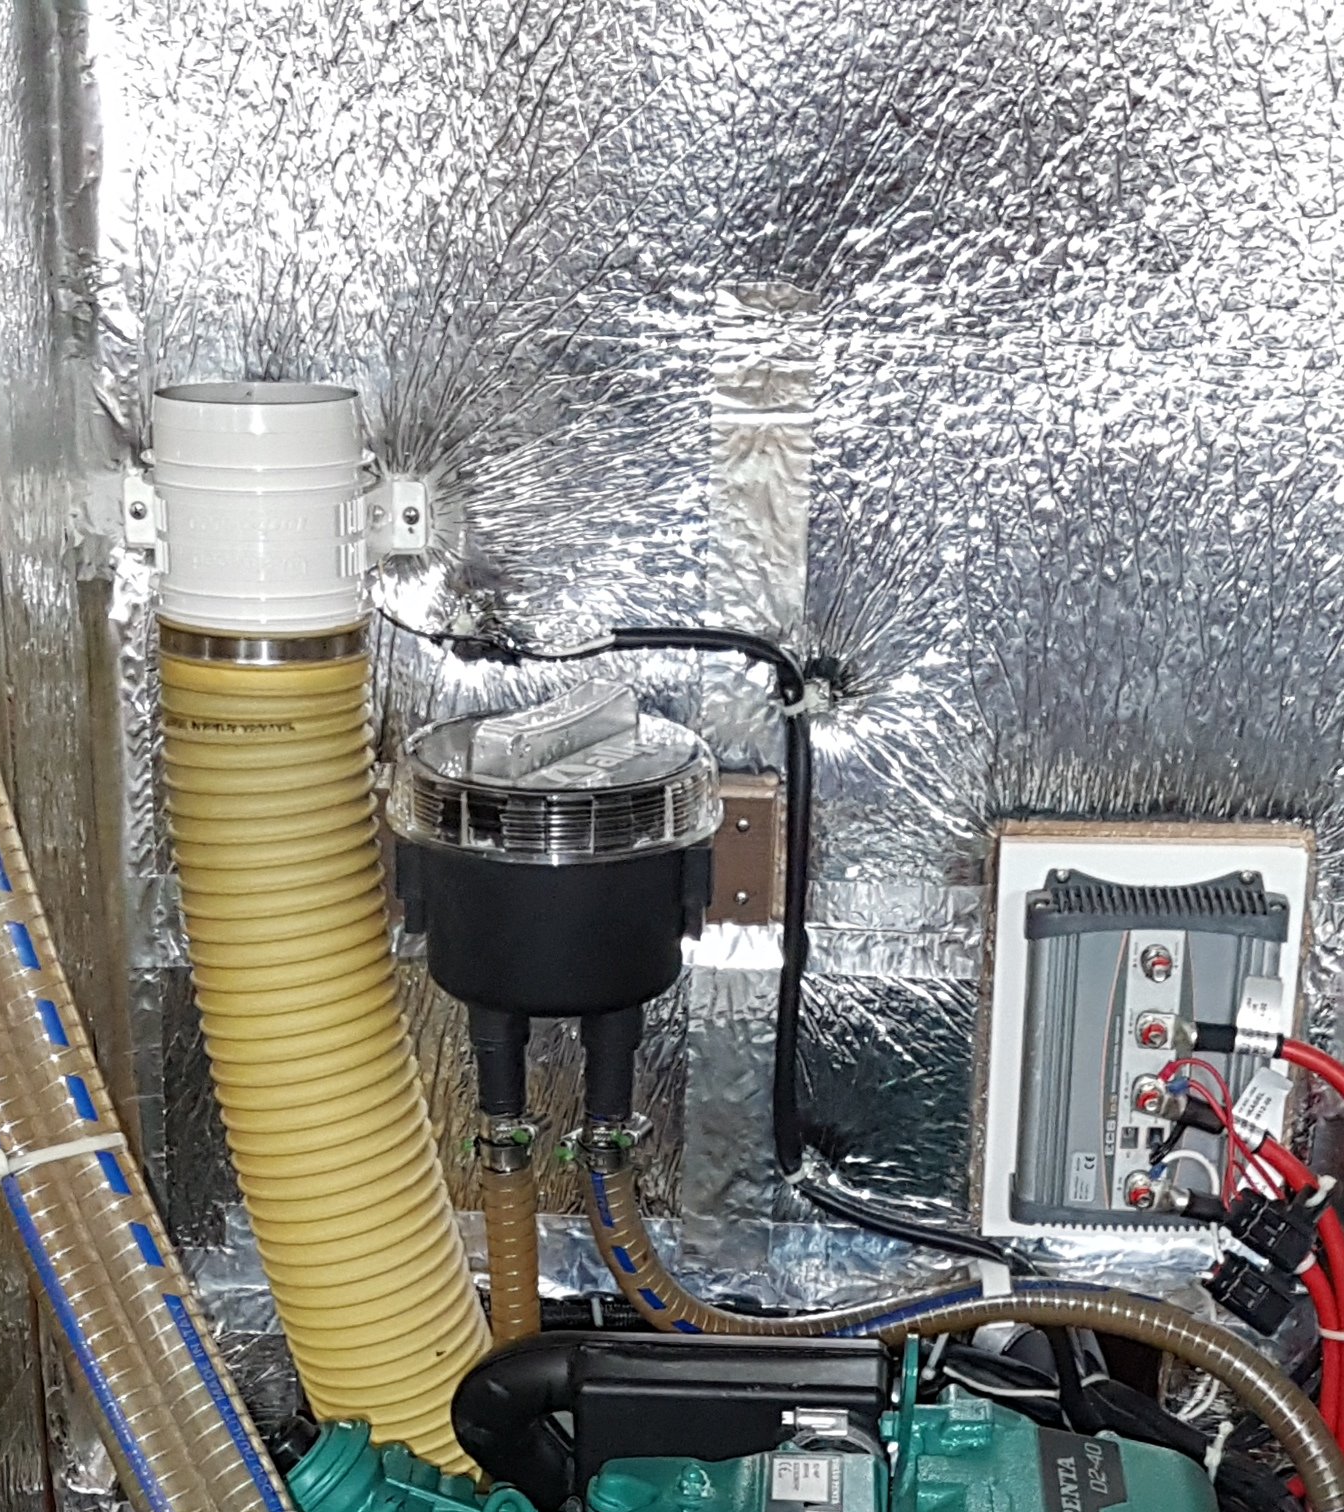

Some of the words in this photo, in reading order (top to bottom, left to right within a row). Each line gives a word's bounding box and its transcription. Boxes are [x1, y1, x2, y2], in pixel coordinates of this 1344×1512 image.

[169, 1300, 197, 1341] ITALY
[197, 1358, 227, 1401] MADE
[219, 1401, 257, 1462] QUALITY
[1084, 1442, 1108, 1495] D2-40
